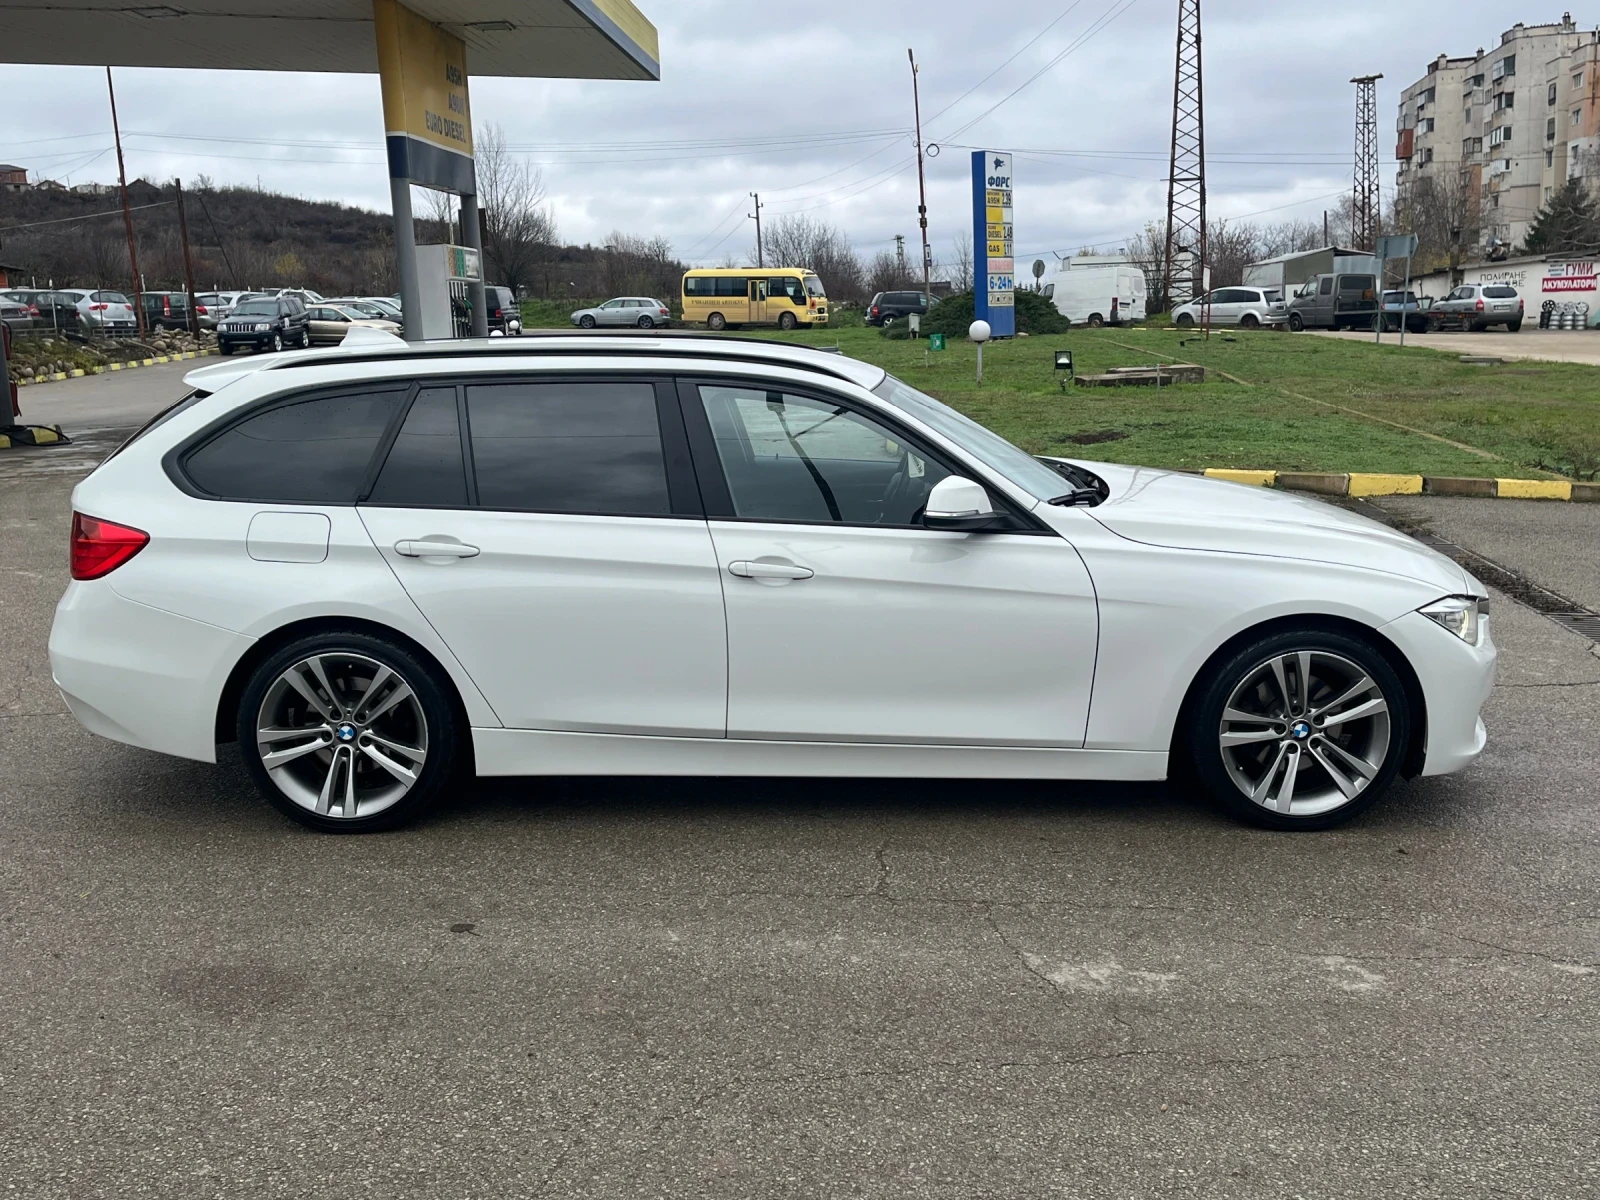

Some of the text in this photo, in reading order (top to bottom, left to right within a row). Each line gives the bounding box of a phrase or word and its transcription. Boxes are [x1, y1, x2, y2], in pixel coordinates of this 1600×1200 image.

[425, 109, 466, 143] EURO DIESEL
[988, 176, 1010, 188] ФОРС
[988, 230, 1002, 239] DIESEL
[988, 244, 1000, 252] GAS
[1565, 262, 1593, 276] ГУМИ
[1480, 270, 1527, 281] ПОЛИРАНЕ
[1543, 278, 1597, 290] АКУМУЛАТОРИ
